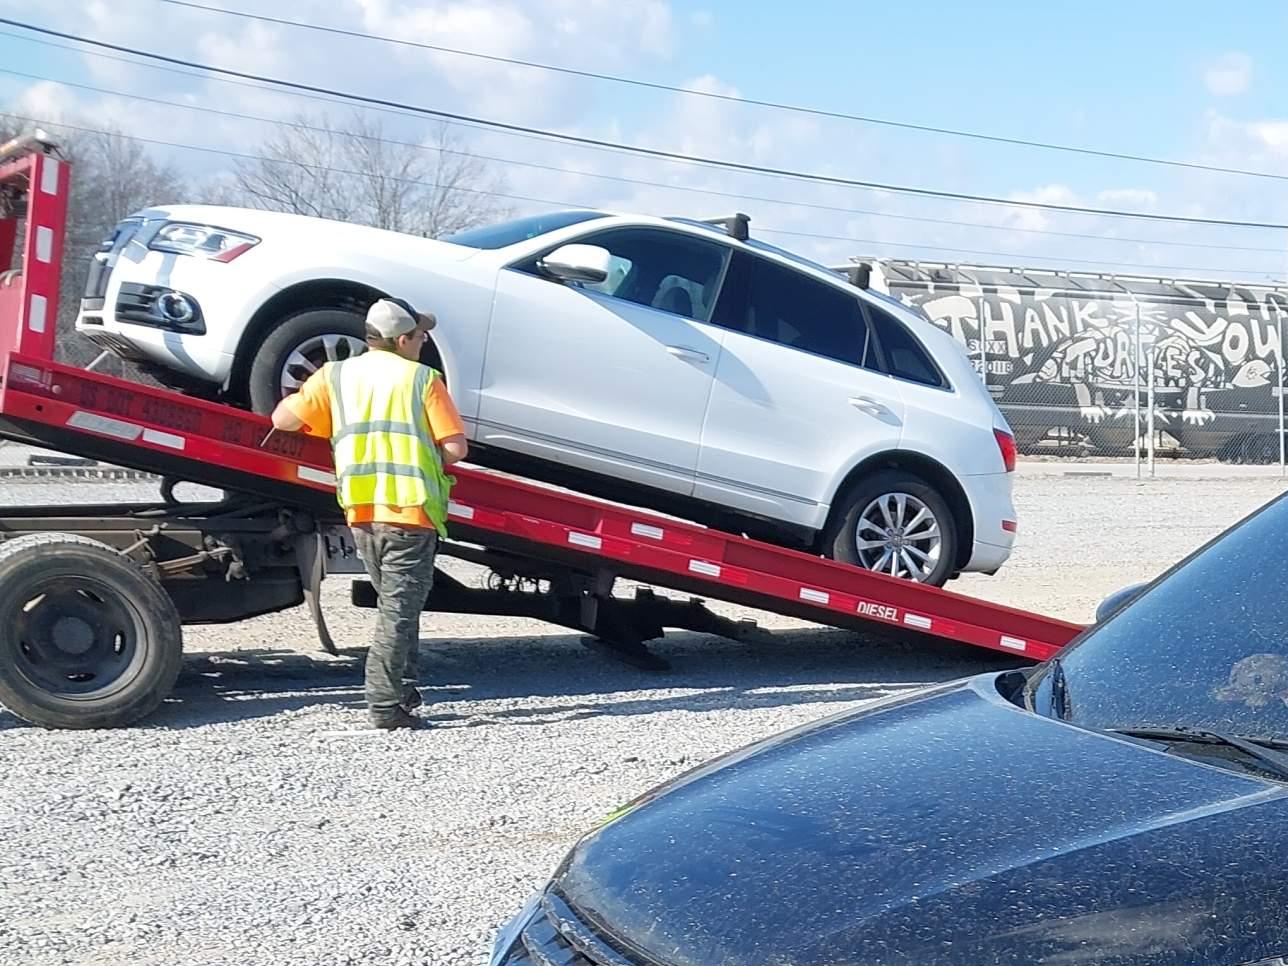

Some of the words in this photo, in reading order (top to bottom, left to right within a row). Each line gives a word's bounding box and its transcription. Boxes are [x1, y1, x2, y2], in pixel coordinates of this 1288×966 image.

[922, 296, 1110, 358] THANK
[1169, 311, 1284, 368] YOU
[857, 601, 899, 622] DIESEL
